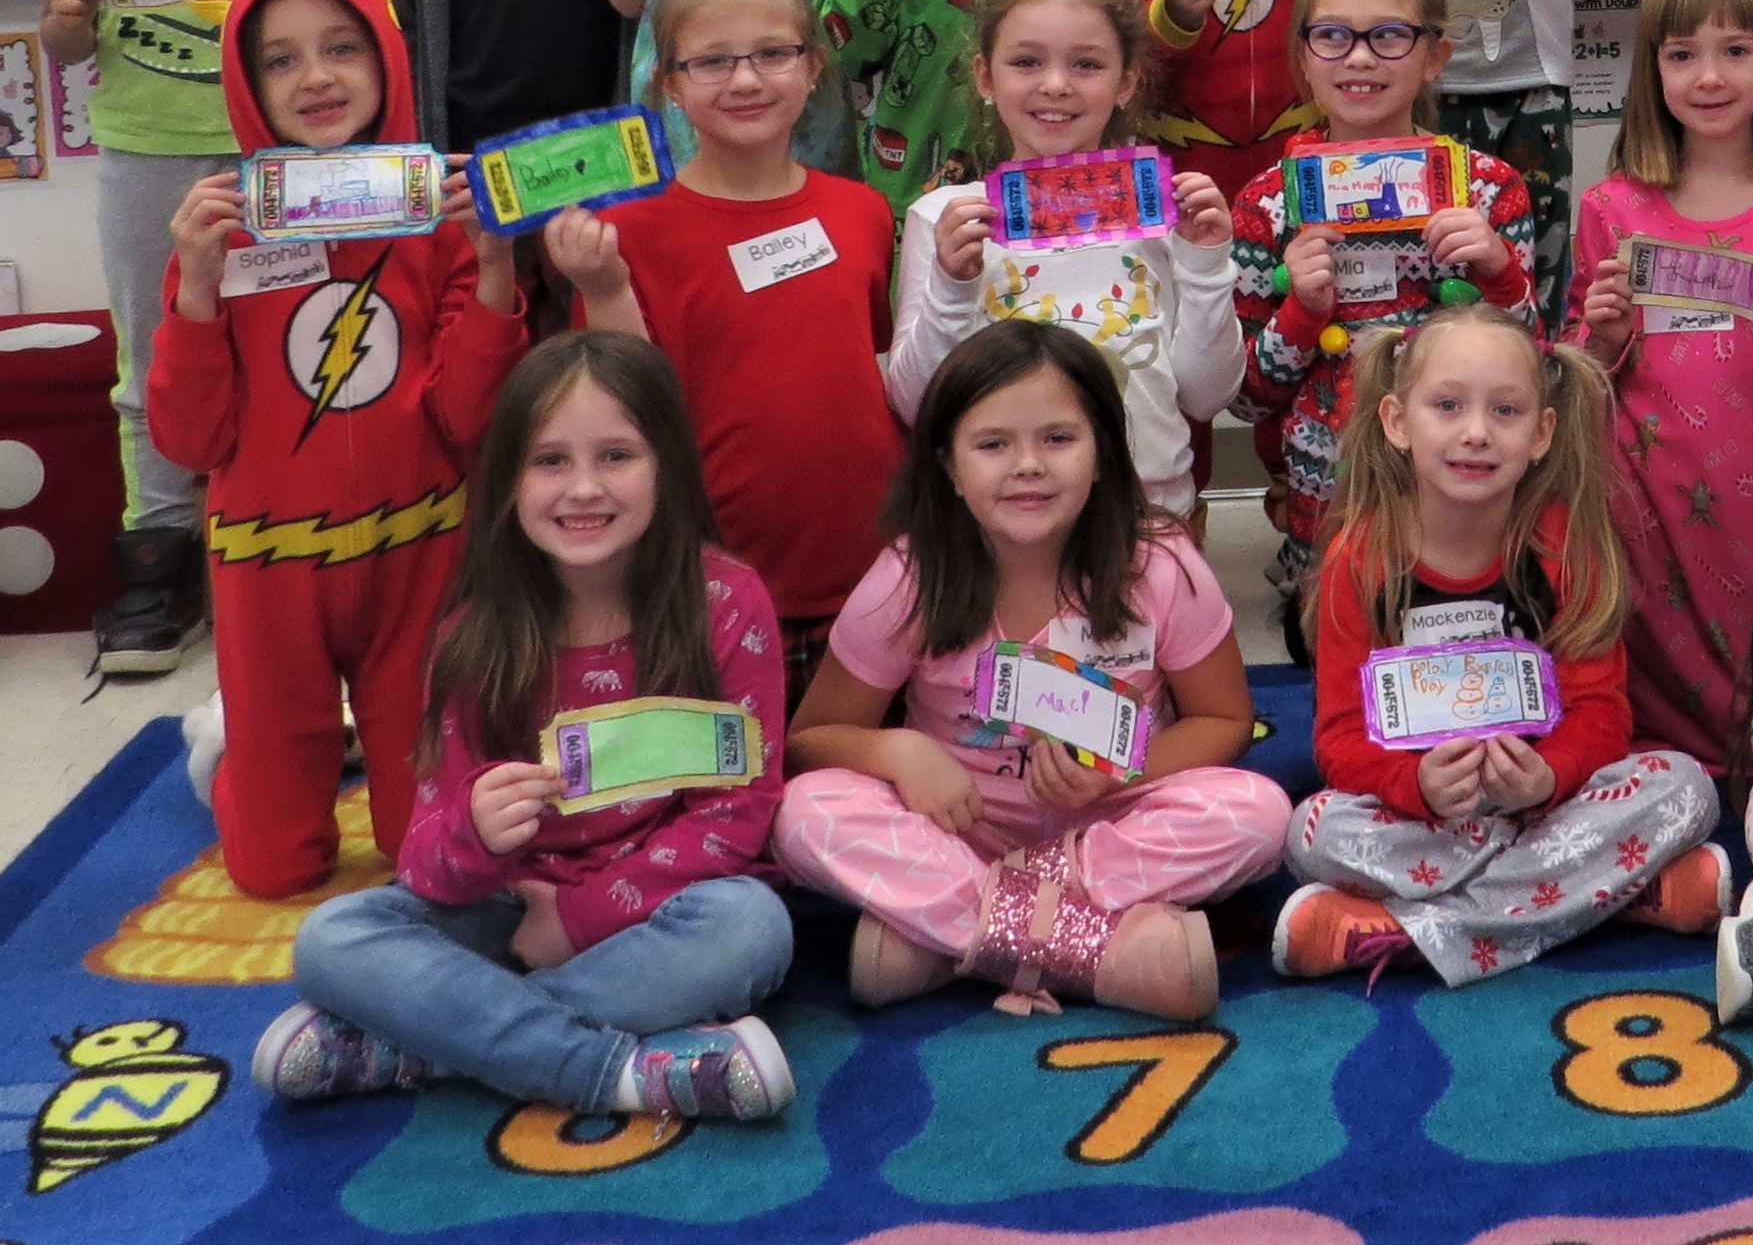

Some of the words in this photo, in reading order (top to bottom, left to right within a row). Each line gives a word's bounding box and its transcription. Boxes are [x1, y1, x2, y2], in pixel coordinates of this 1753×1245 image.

[748, 230, 810, 262] Bailey
[1334, 260, 1365, 276] Mia
[1411, 608, 1498, 631] Mackenzie
[1420, 678, 1447, 697] Day
[1553, 989, 1750, 1117] 8
[1037, 1030, 1238, 1167] 7
